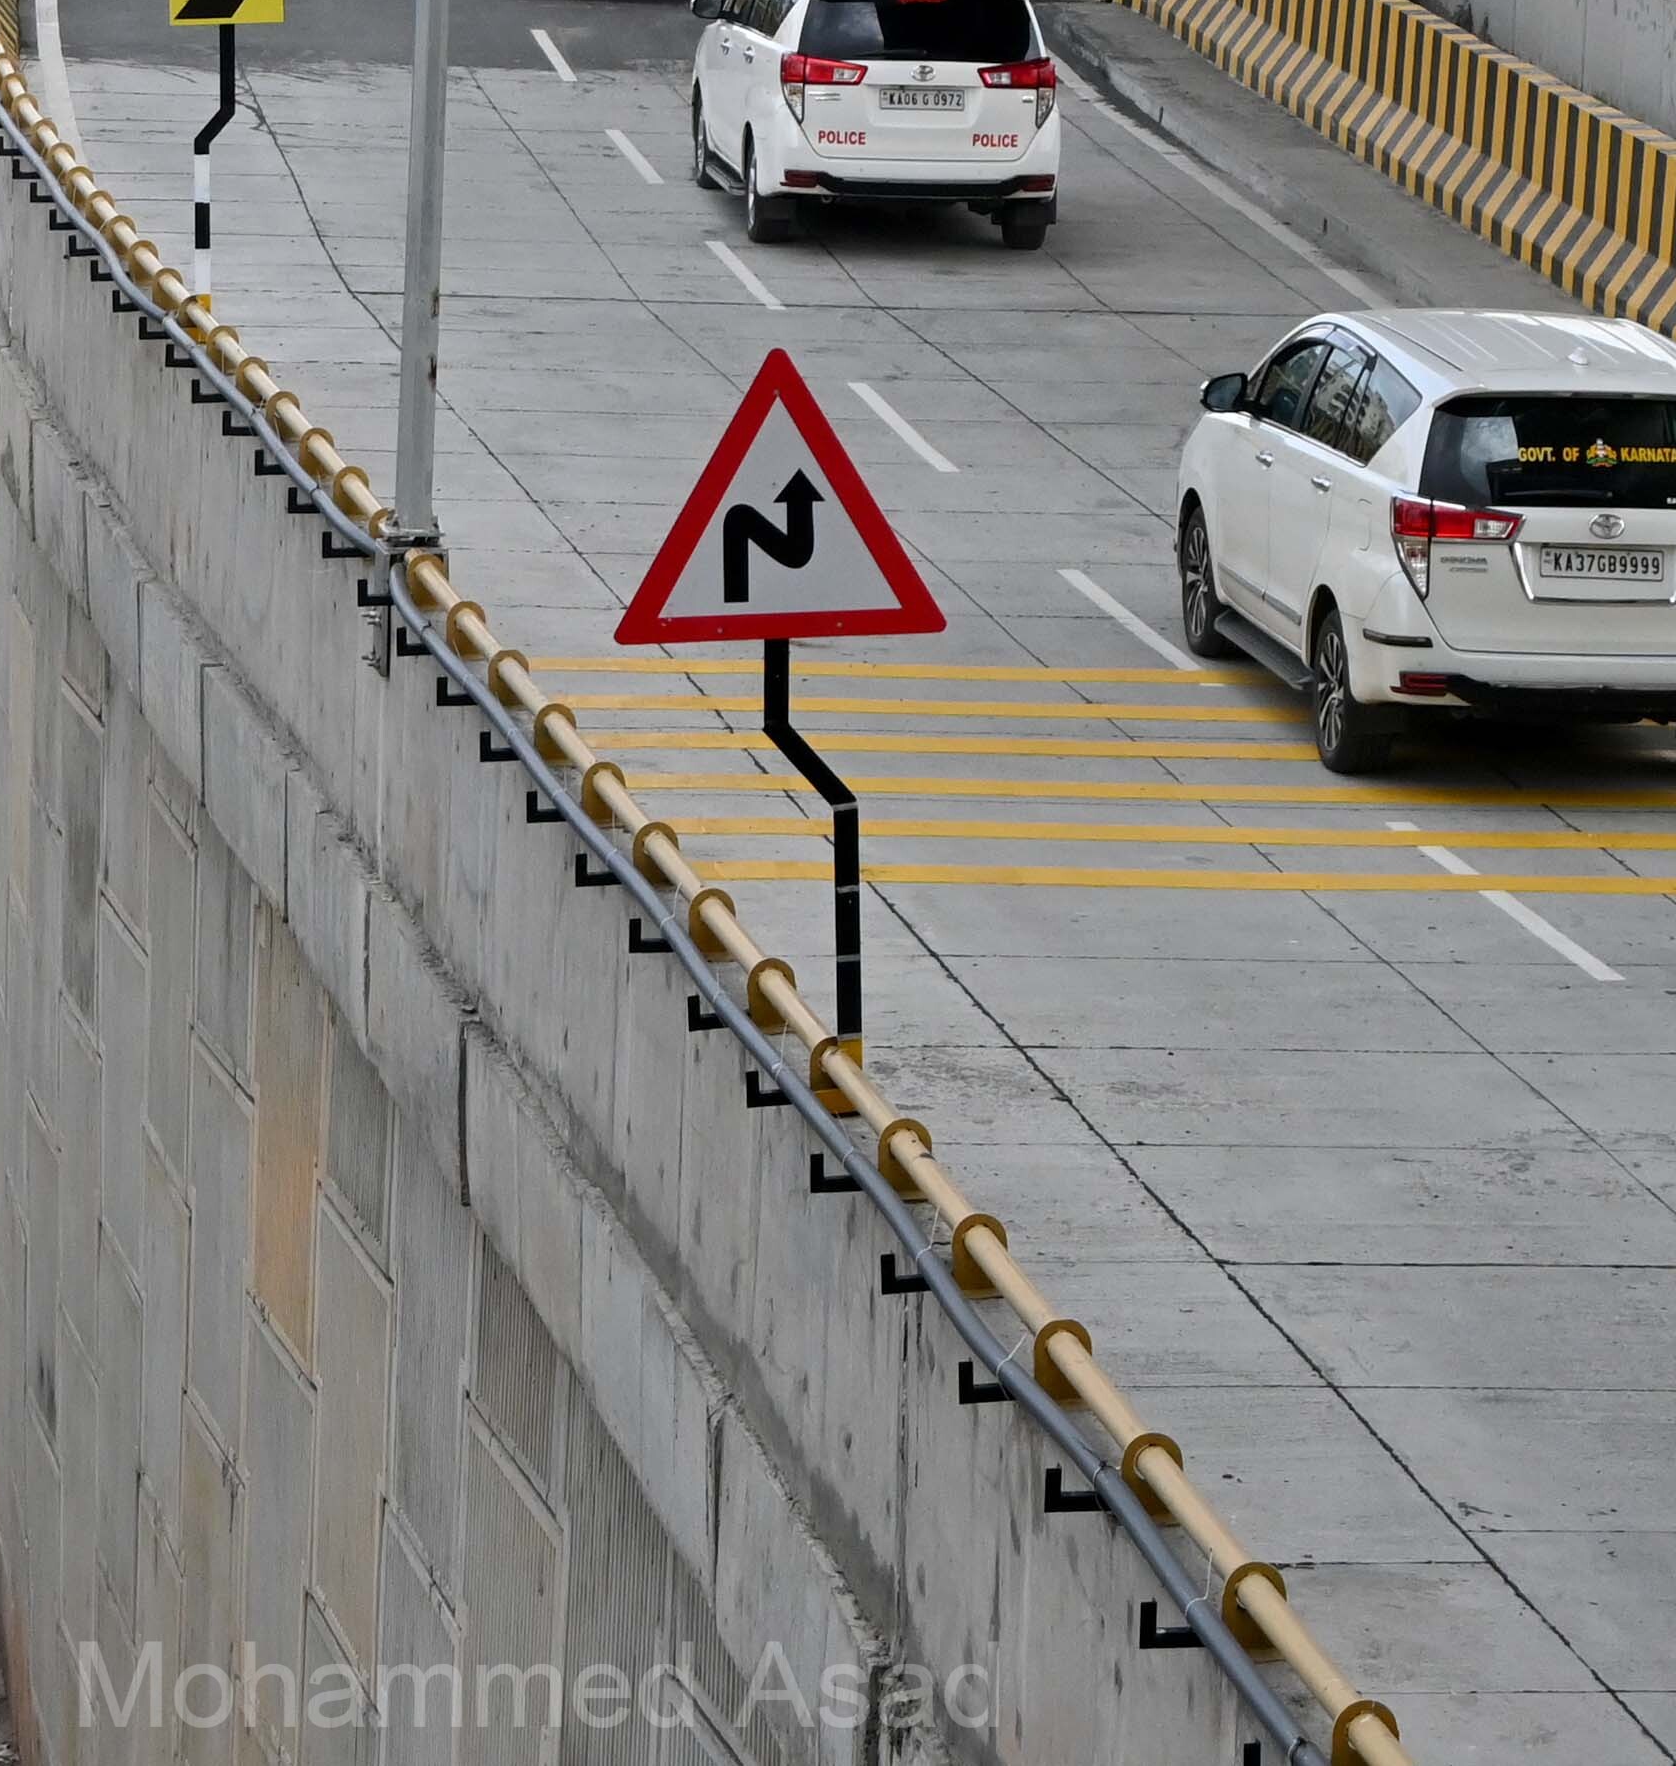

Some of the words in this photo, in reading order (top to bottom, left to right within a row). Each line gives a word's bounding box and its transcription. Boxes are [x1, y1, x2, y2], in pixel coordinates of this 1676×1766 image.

[889, 92, 918, 106] KA06
[923, 94, 929, 105] G
[933, 93, 962, 107] 0972
[818, 130, 867, 145] POLICE
[972, 134, 1019, 148] POLICE
[1518, 447, 1556, 462] GOVT.
[1562, 447, 1581, 462] OF
[1553, 552, 1660, 575] KA37GB9999
